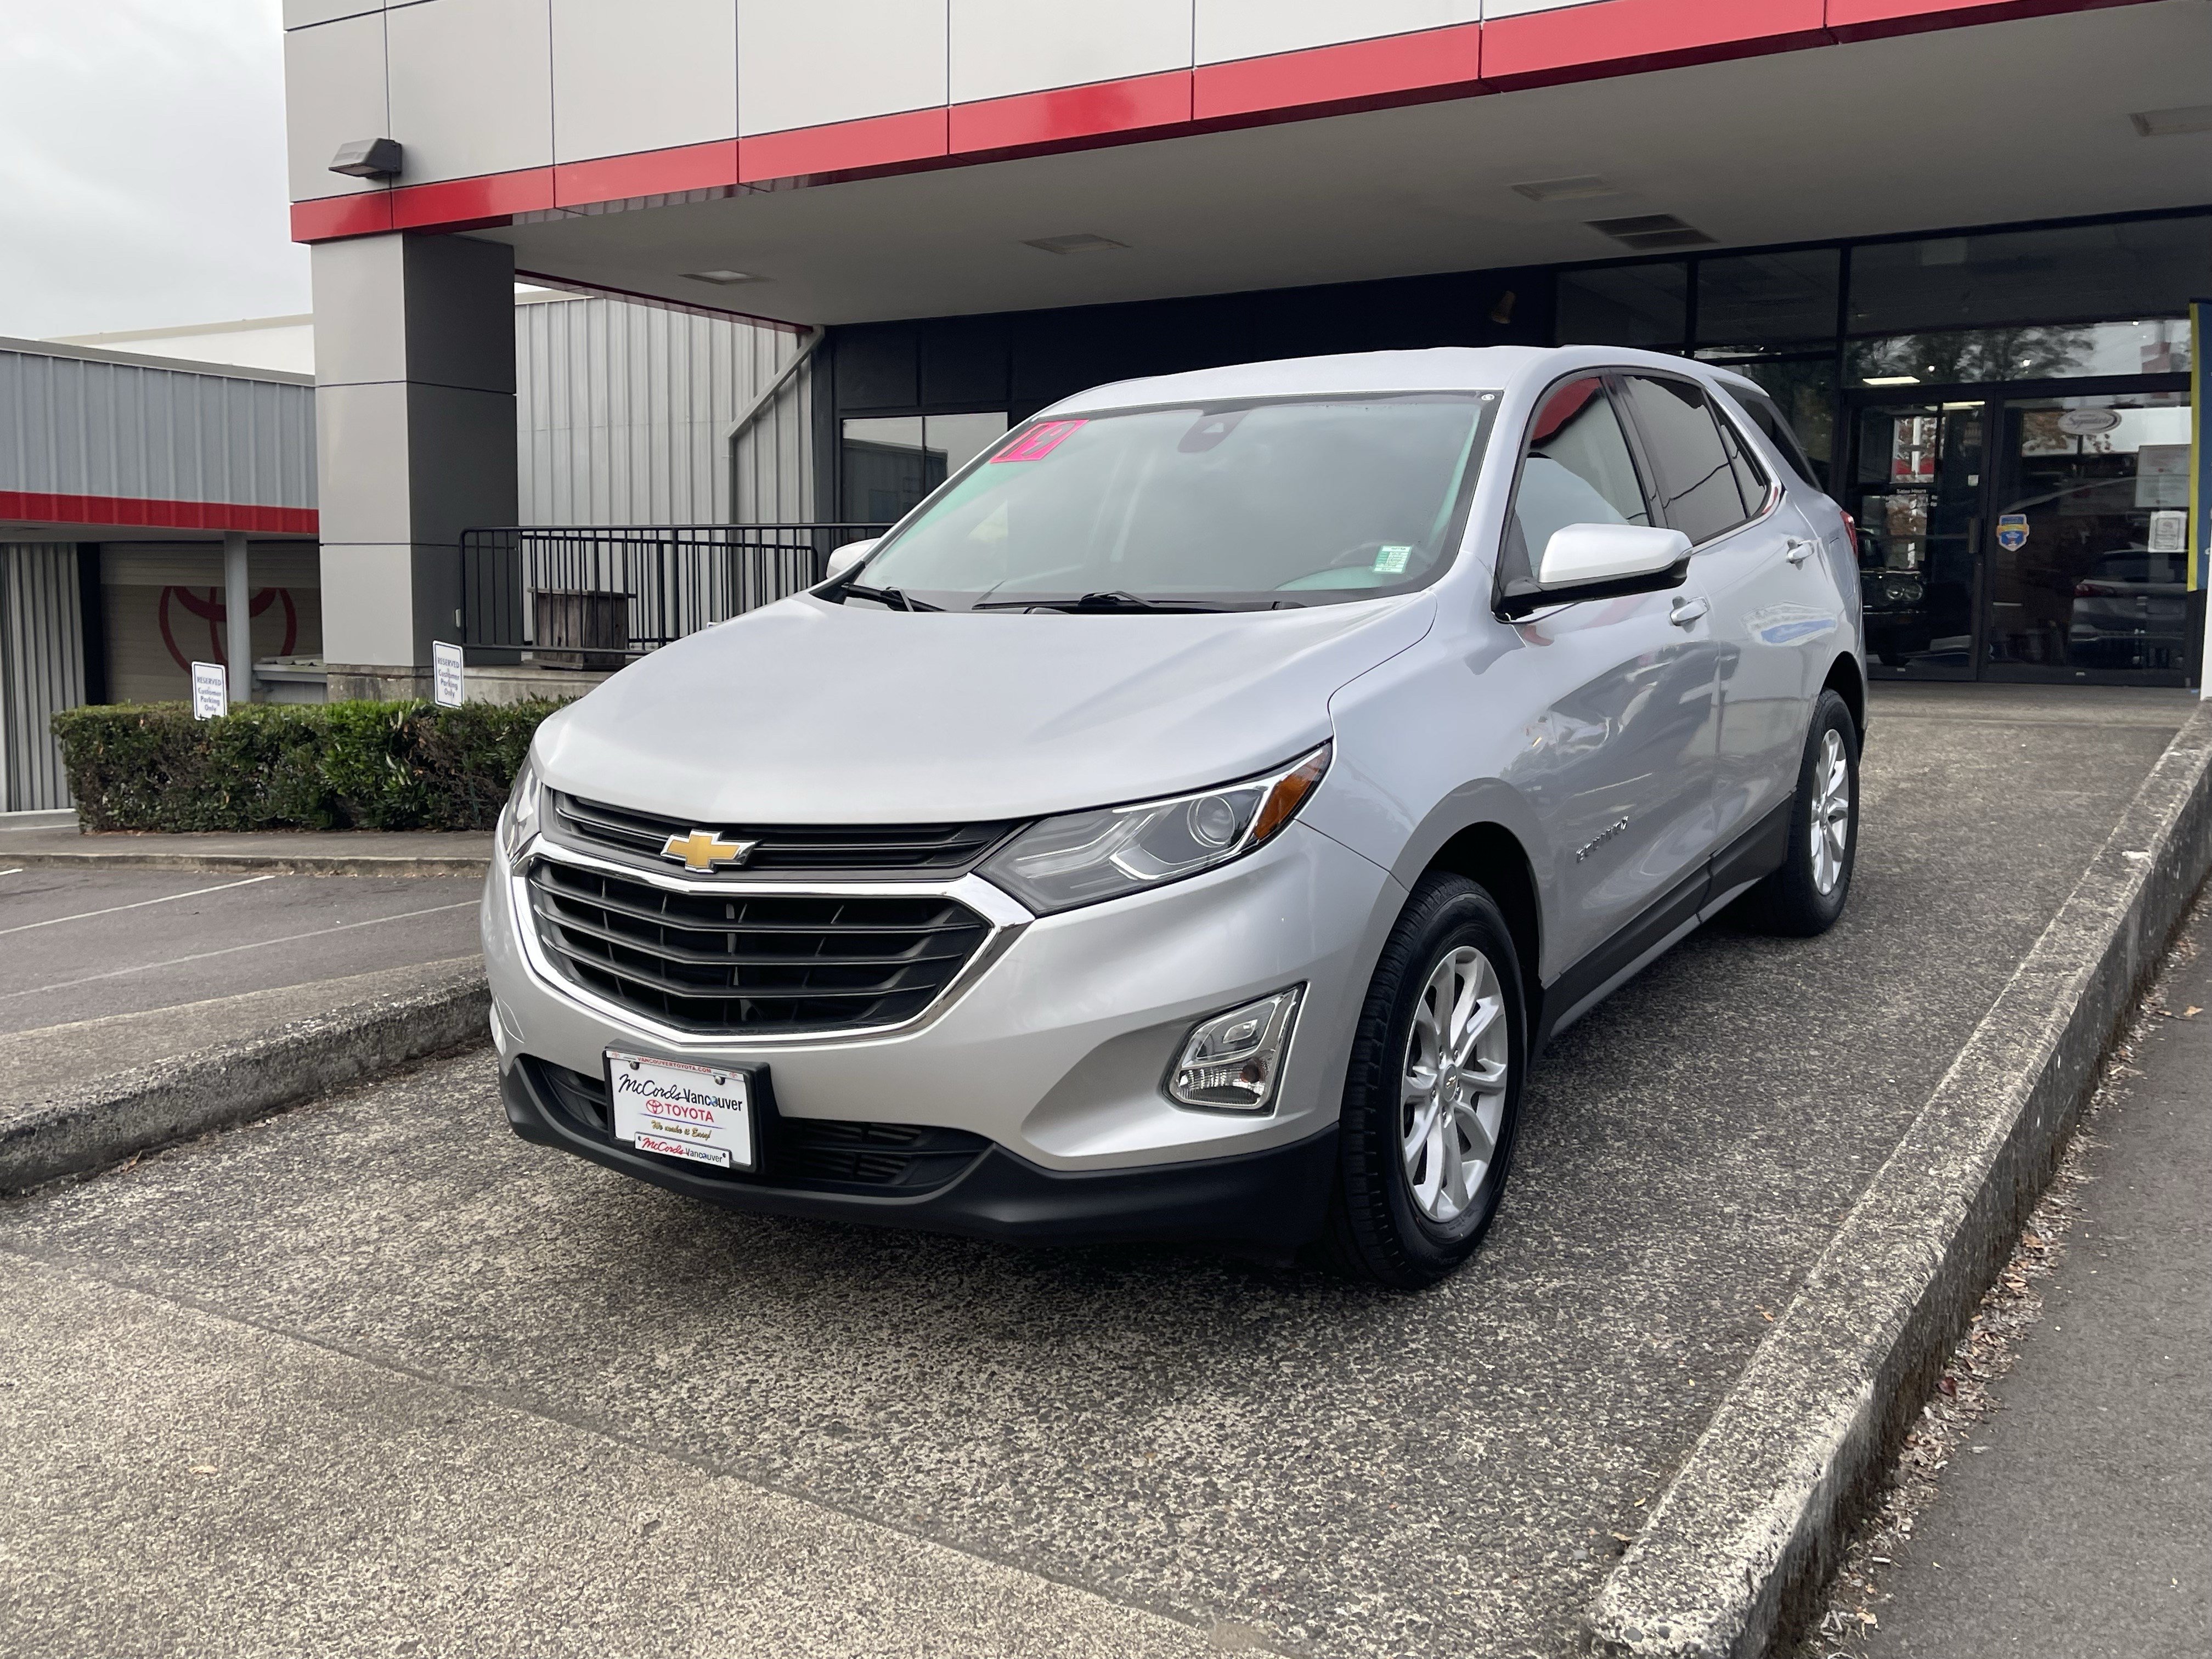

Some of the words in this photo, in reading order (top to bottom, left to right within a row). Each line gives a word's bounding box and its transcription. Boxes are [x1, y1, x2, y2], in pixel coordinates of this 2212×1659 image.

[997, 421, 1077, 459] 19
[438, 657, 460, 668] RESERVED
[438, 669, 460, 680] Customer
[197, 676, 222, 686] RESERVED
[441, 678, 458, 691] Parking
[198, 687, 221, 696] Customer
[444, 688, 455, 698] Only
[201, 696, 220, 706] Parking
[205, 704, 217, 712] Only
[665, 1103, 714, 1122] TOYOTA
